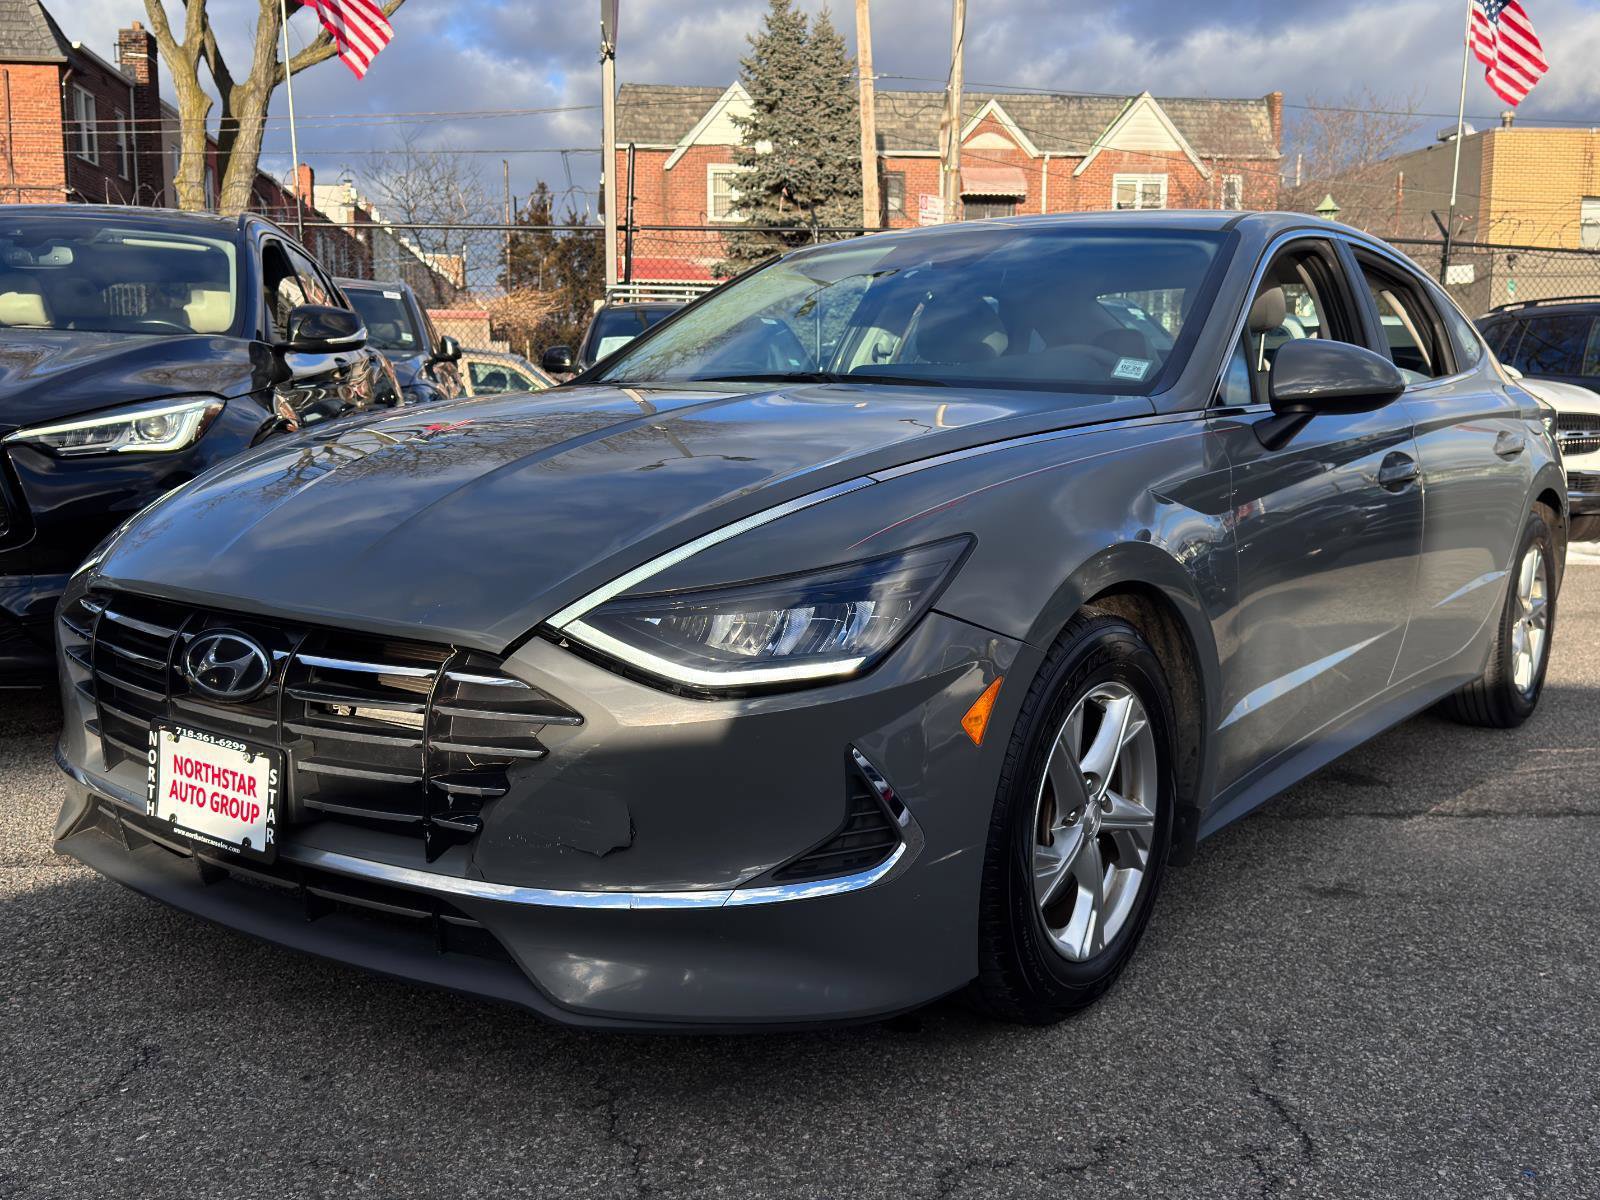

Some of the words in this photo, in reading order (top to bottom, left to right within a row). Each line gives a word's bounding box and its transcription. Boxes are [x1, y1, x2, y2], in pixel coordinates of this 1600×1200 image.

[175, 726, 247, 752] 718-361-6299
[146, 730, 158, 817] NORTH
[173, 753, 257, 798] NORTHSTAR
[169, 779, 207, 808] AUTO
[210, 791, 260, 824] GROUP
[266, 768, 278, 844] STAR
